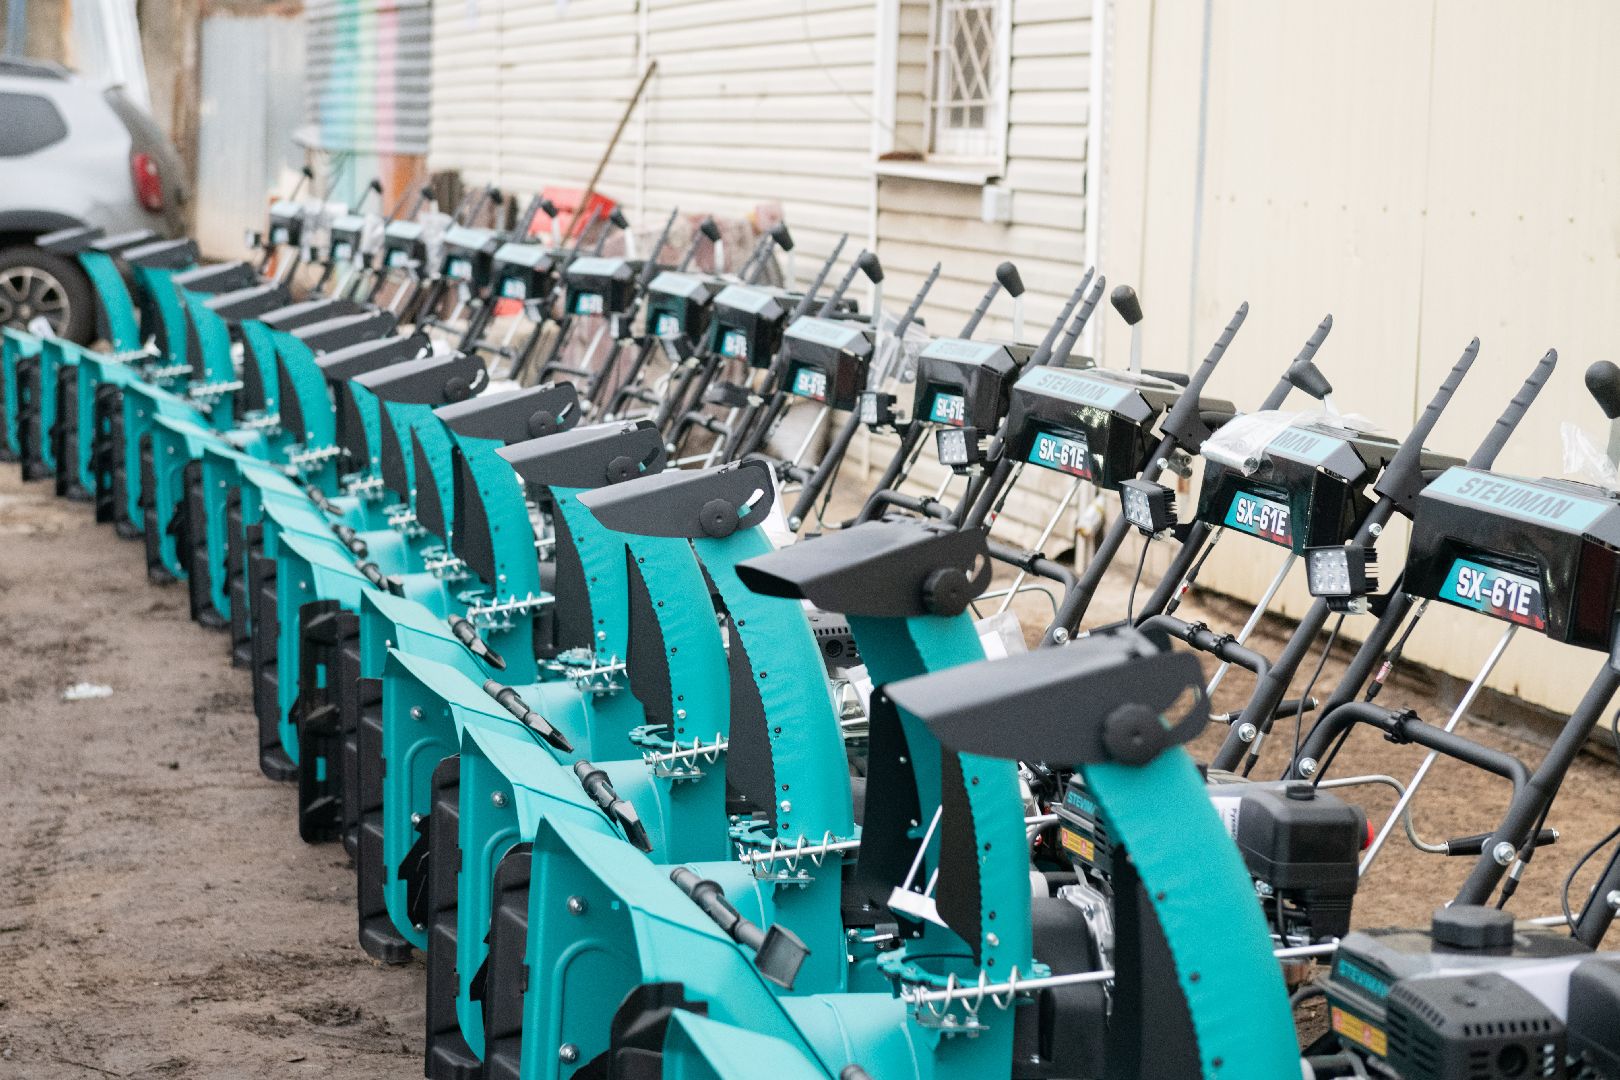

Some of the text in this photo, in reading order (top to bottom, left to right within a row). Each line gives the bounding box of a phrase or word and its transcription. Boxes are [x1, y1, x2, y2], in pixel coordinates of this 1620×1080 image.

[1037, 372, 1110, 400] STEVIMAN
[1038, 437, 1085, 471] SX-61E
[1235, 496, 1288, 537] SX-61E
[1456, 477, 1575, 520] STEVIMAN
[1456, 566, 1533, 617] SX-61E
